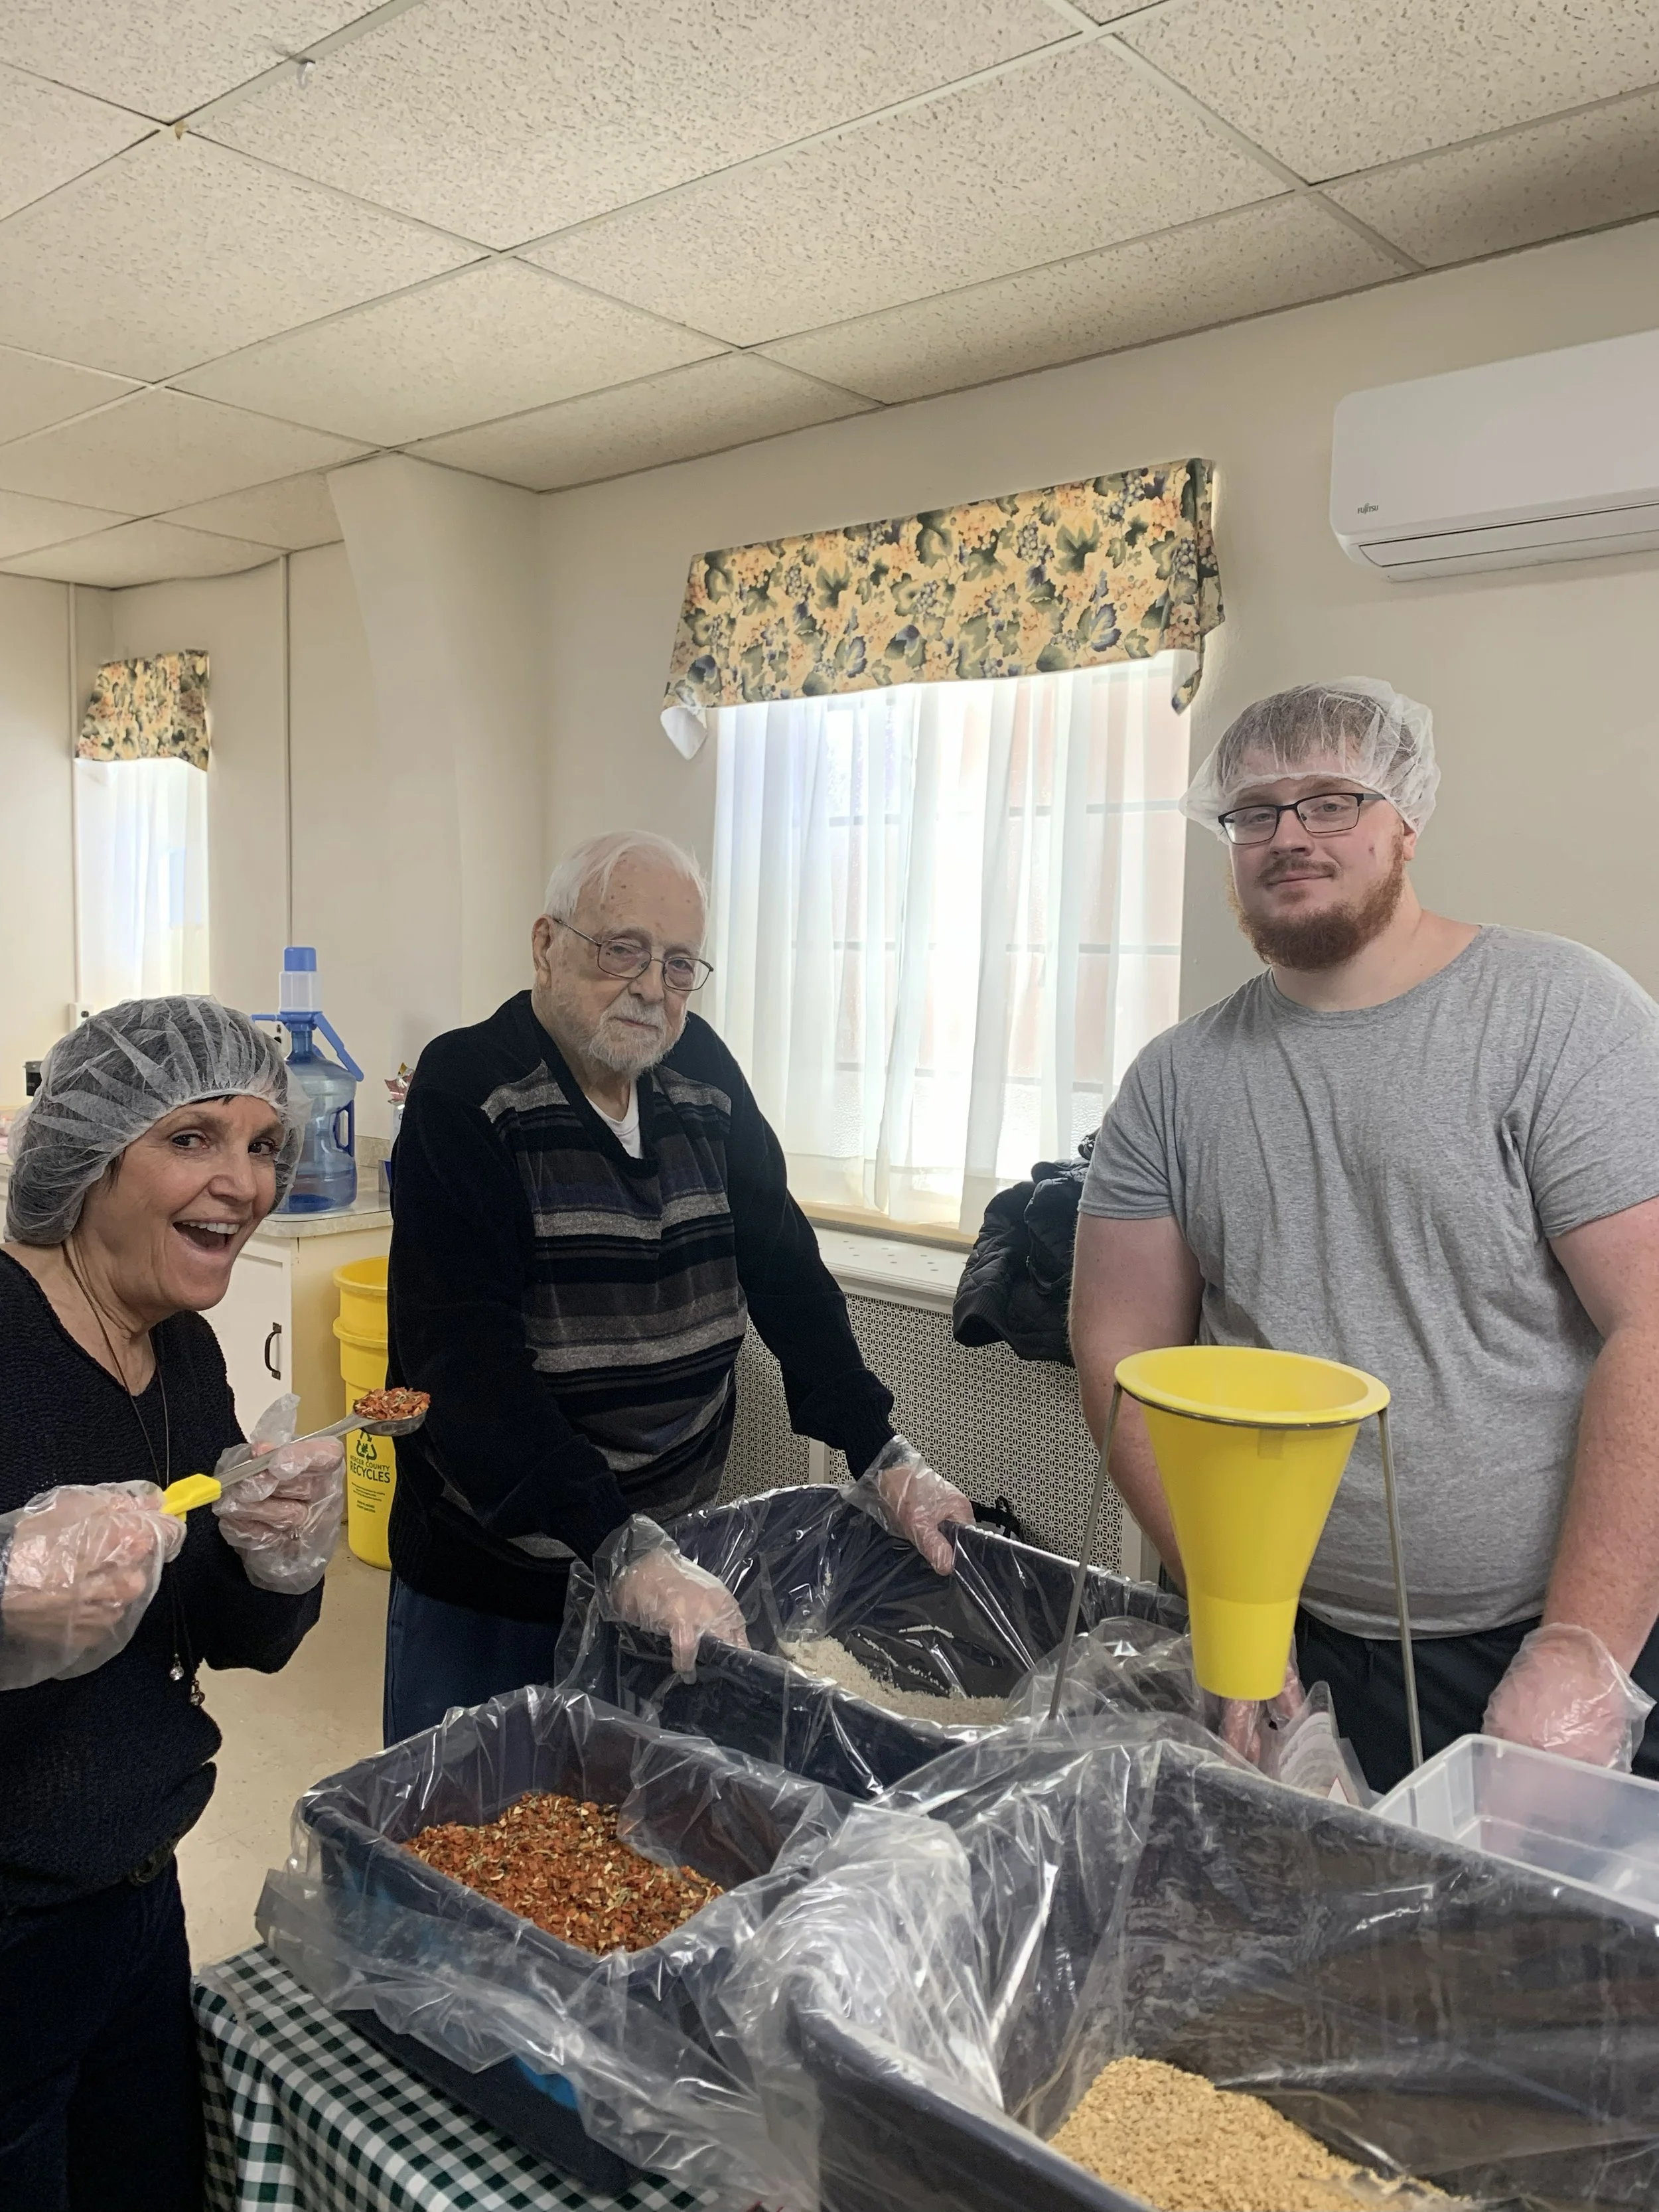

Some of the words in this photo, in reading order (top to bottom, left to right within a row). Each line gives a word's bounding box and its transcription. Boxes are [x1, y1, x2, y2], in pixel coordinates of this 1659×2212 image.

[1357, 502, 1378, 514] FUJITSU
[350, 1460, 390, 1483] RECYCLES
[366, 1461, 390, 1471] COUNTY
